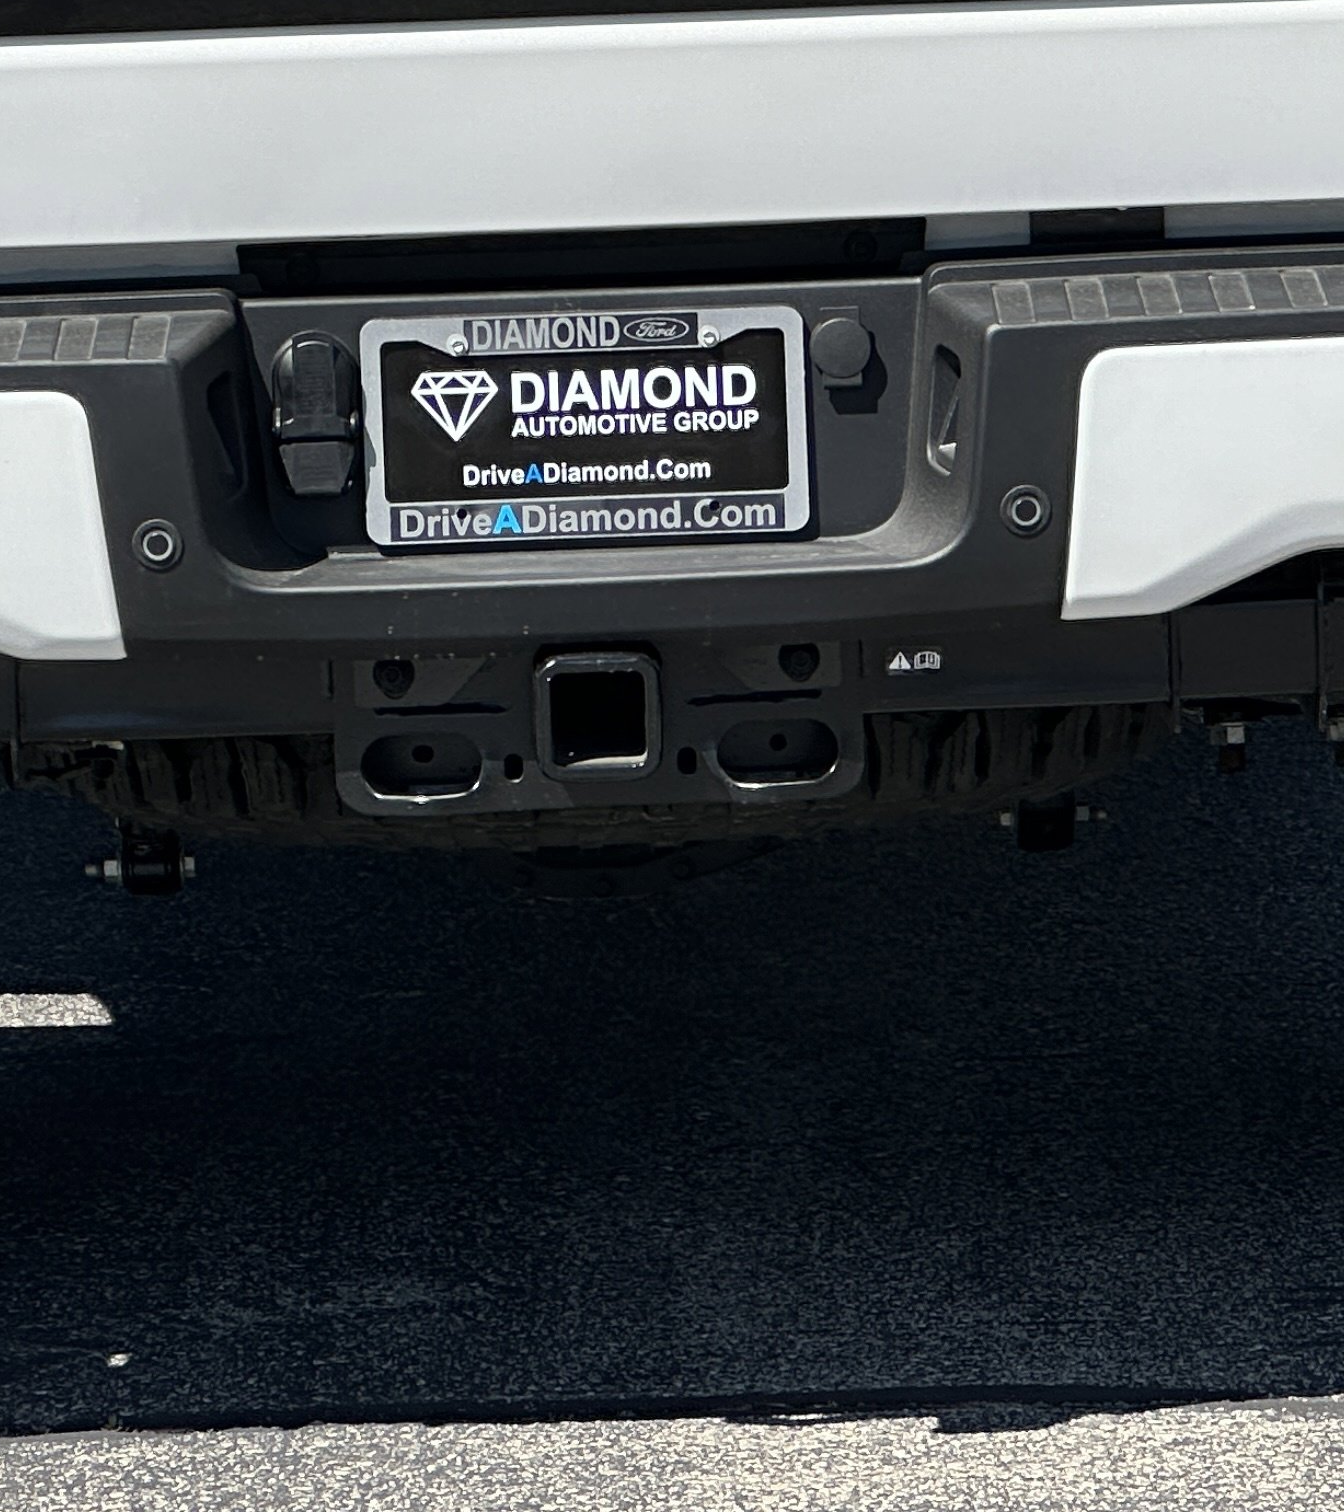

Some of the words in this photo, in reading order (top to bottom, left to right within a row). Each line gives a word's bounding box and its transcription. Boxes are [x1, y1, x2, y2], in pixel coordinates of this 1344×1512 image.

[472, 316, 620, 351] DIAMOND
[510, 365, 757, 413] DIAMOND
[511, 413, 667, 437] AUTOMOTIVE
[673, 409, 760, 431] GROUP
[463, 458, 711, 487] DriveADiamond.Com
[399, 499, 776, 538] DriveADiamond.Com
